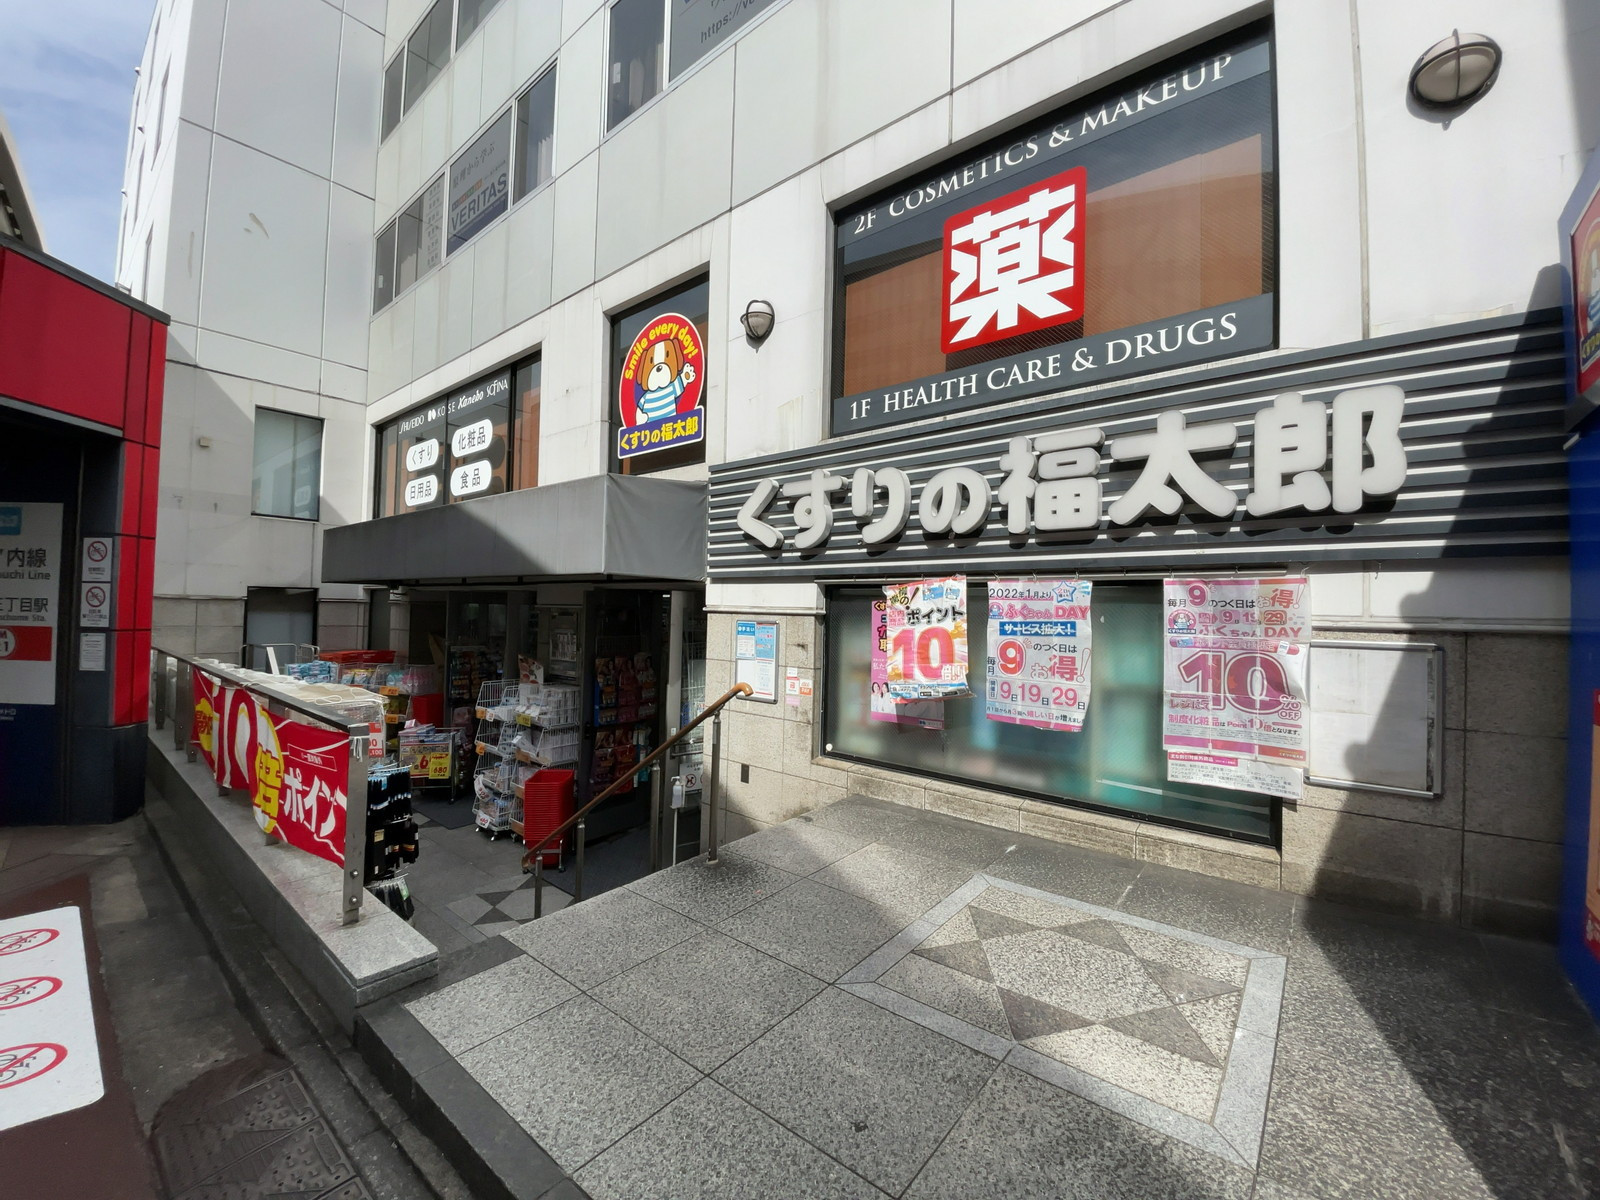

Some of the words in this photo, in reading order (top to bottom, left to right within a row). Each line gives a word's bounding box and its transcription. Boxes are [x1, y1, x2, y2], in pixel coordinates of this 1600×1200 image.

[854, 209, 877, 235] 2F
[889, 135, 1039, 217] COSMETICS
[1049, 123, 1074, 148] &
[1079, 53, 1232, 136] MAKEUP
[451, 172, 507, 231] VERITAS
[949, 182, 1076, 346] 薬
[648, 322, 679, 341] every
[850, 399, 871, 420] 1F
[883, 374, 978, 414] HEALTH
[986, 354, 1061, 390] CARE
[1071, 347, 1097, 371] &
[1105, 312, 1238, 365] DRUGS
[457, 390, 484, 410] Kanebo
[486, 378, 509, 398] SOFINA
[458, 426, 486, 451] 化粧品
[620, 416, 699, 450] くすりの福太郎
[411, 444, 433, 465] くすり
[736, 384, 1407, 549] くすりの福太郎
[460, 468, 481, 490] 食品
[410, 480, 432, 500] 日用品
[0, 548, 47, 568] 内線
[28, 571, 51, 580] Line
[989, 588, 1052, 599] 2022年1月より
[906, 606, 964, 627] ポイント
[1005, 604, 1053, 620] ふくちゃん
[1054, 605, 1090, 620] DAY
[1003, 622, 1072, 635] サービス拡大!
[1264, 627, 1302, 638] DAY
[892, 626, 955, 680] 10
[997, 638, 1026, 676] 9
[987, 656, 996, 675] 毎月
[1227, 720, 1247, 729] Point
[1278, 710, 1302, 720] OFF
